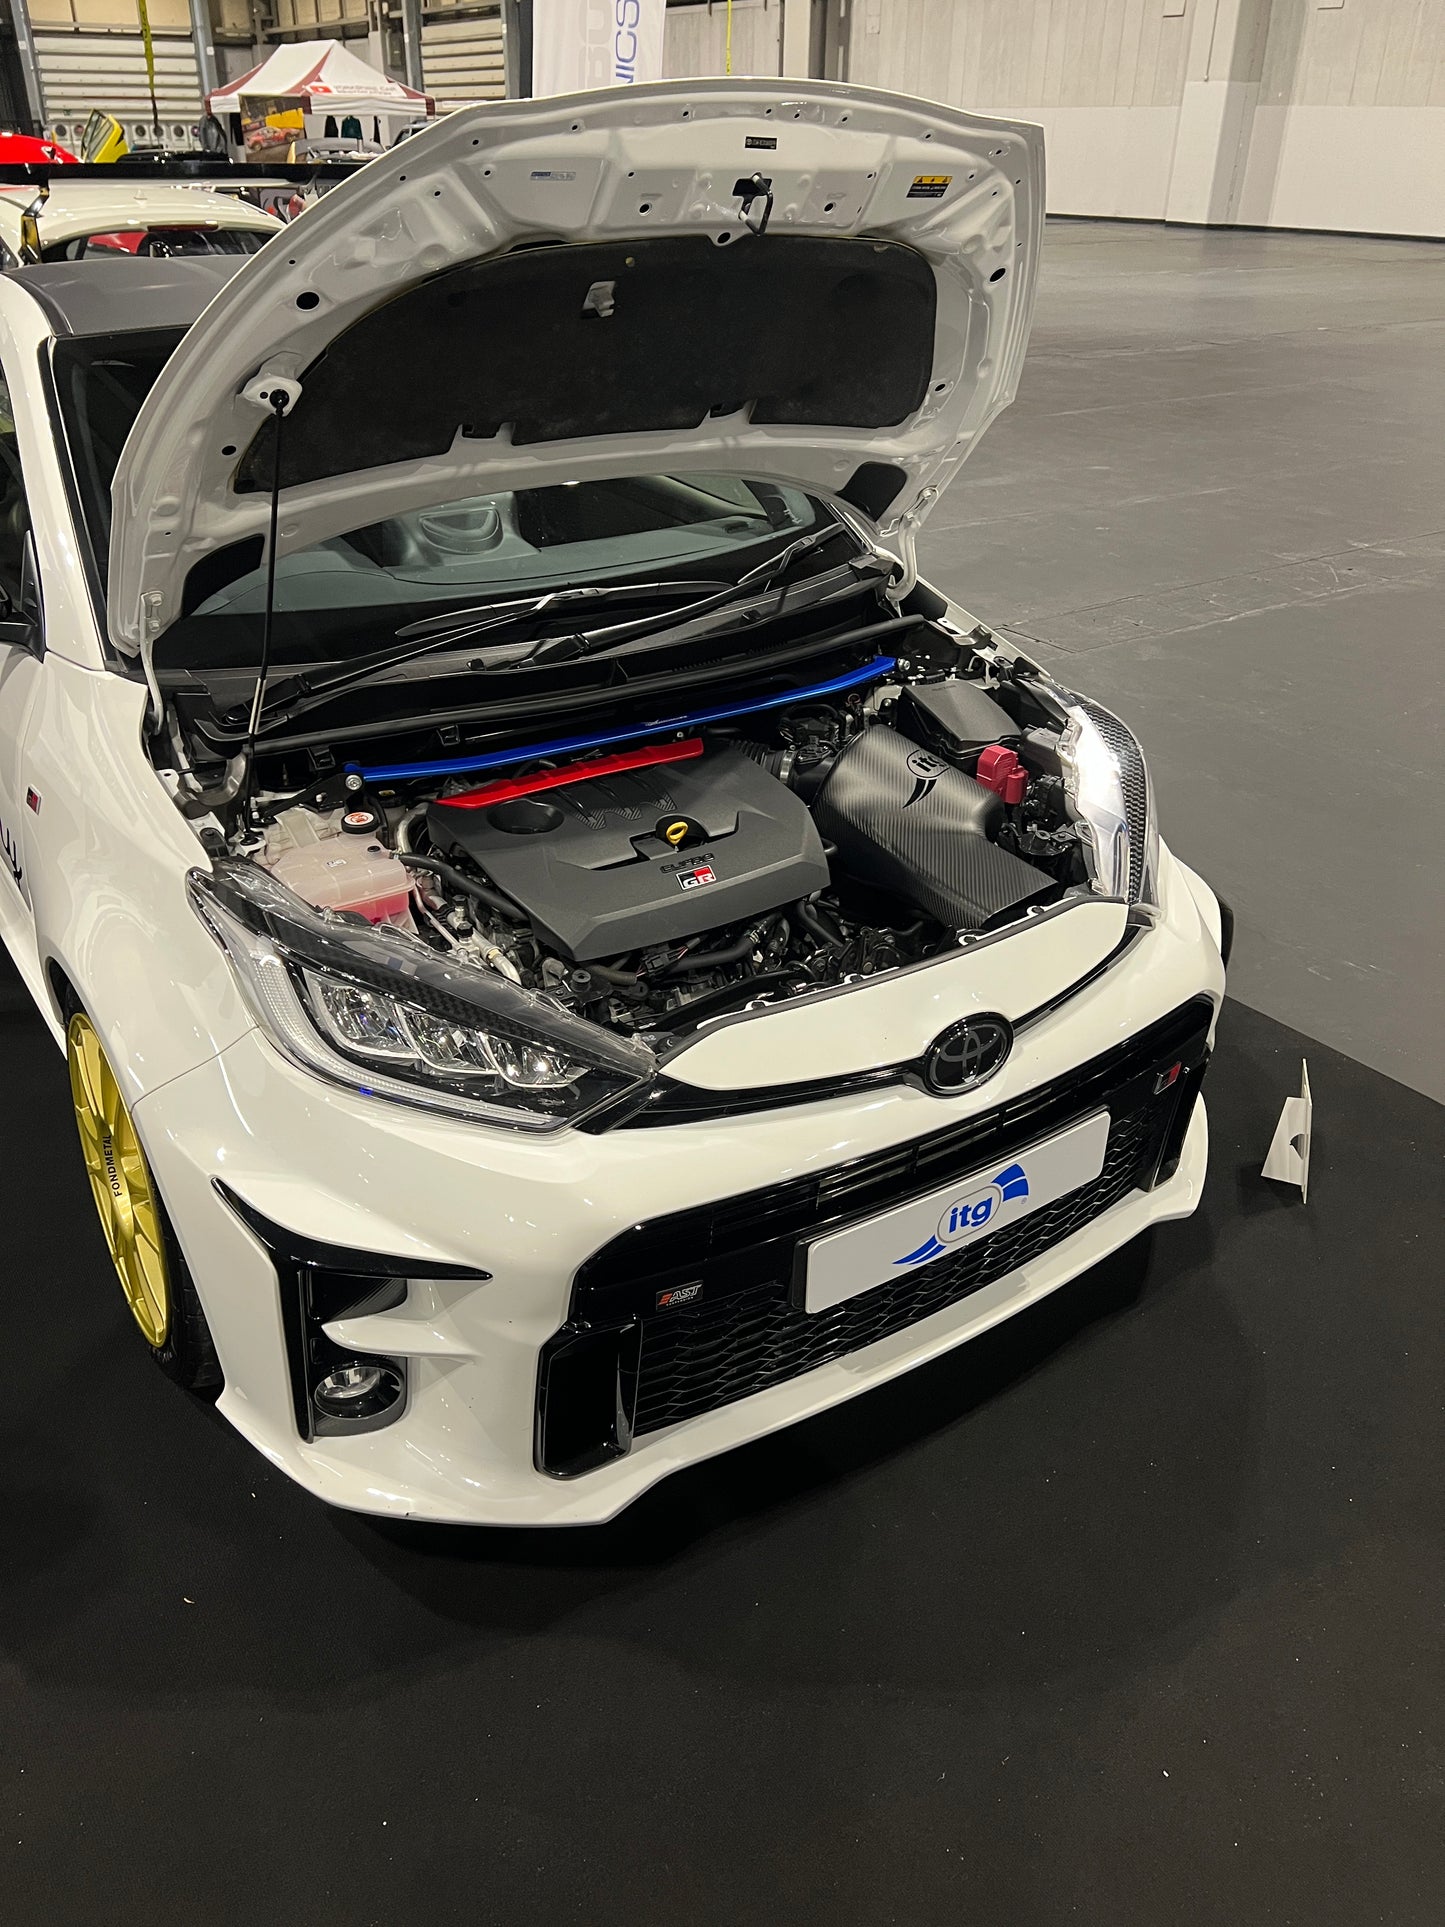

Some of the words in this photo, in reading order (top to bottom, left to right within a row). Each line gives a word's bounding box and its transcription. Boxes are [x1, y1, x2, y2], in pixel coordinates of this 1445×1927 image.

[680, 870, 716, 890] GR
[102, 1135, 123, 1198] FONDMETAL
[948, 1196, 993, 1234] itg
